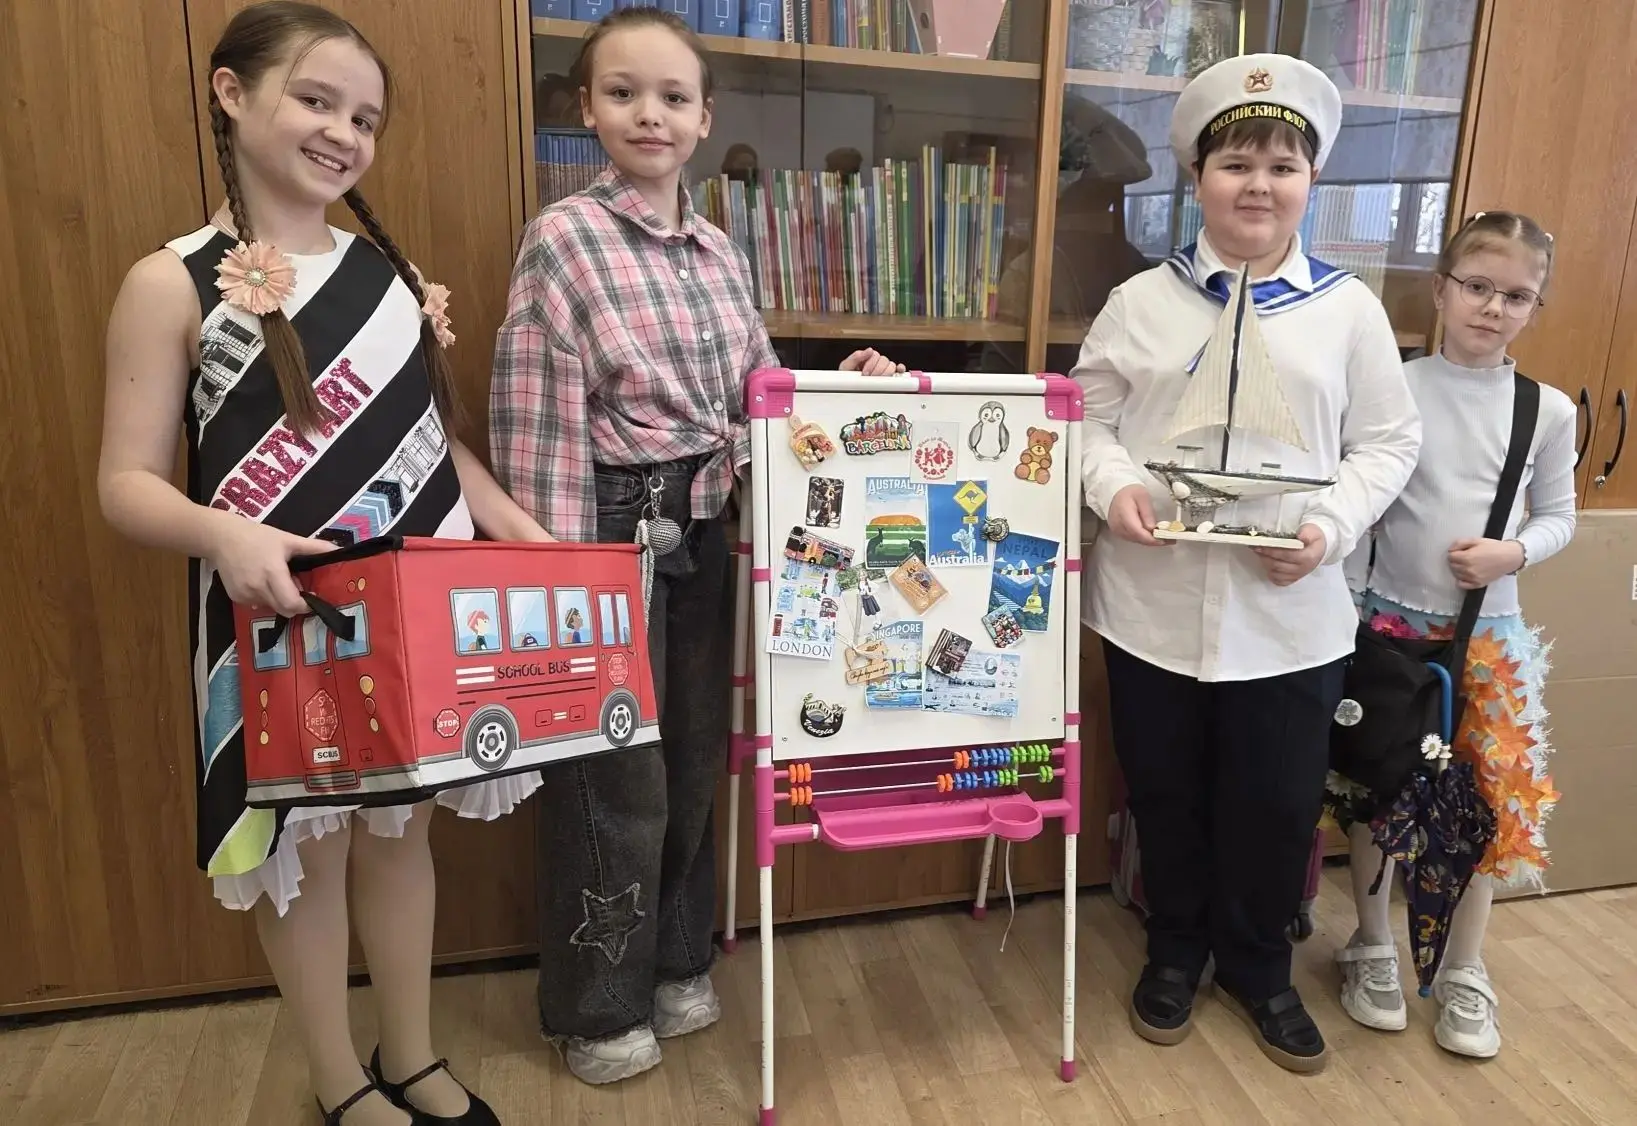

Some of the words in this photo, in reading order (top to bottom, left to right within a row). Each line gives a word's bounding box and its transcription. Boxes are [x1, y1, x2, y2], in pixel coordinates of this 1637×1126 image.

[1210, 104, 1282, 135] РОССИЙСКИЙ
[1283, 110, 1308, 132] ФЛОТ
[846, 435, 911, 455] BARCELONA
[211, 417, 319, 518] RAZY
[867, 478, 926, 496] AUSTRALIA
[929, 553, 985, 566] Australia
[1002, 543, 1048, 558] NEPAL
[772, 639, 833, 657] LONDON
[497, 662, 545, 680] SCHOOL
[548, 660, 570, 674] BUS
[439, 719, 458, 729] STOP
[803, 718, 835, 736] Venezia
